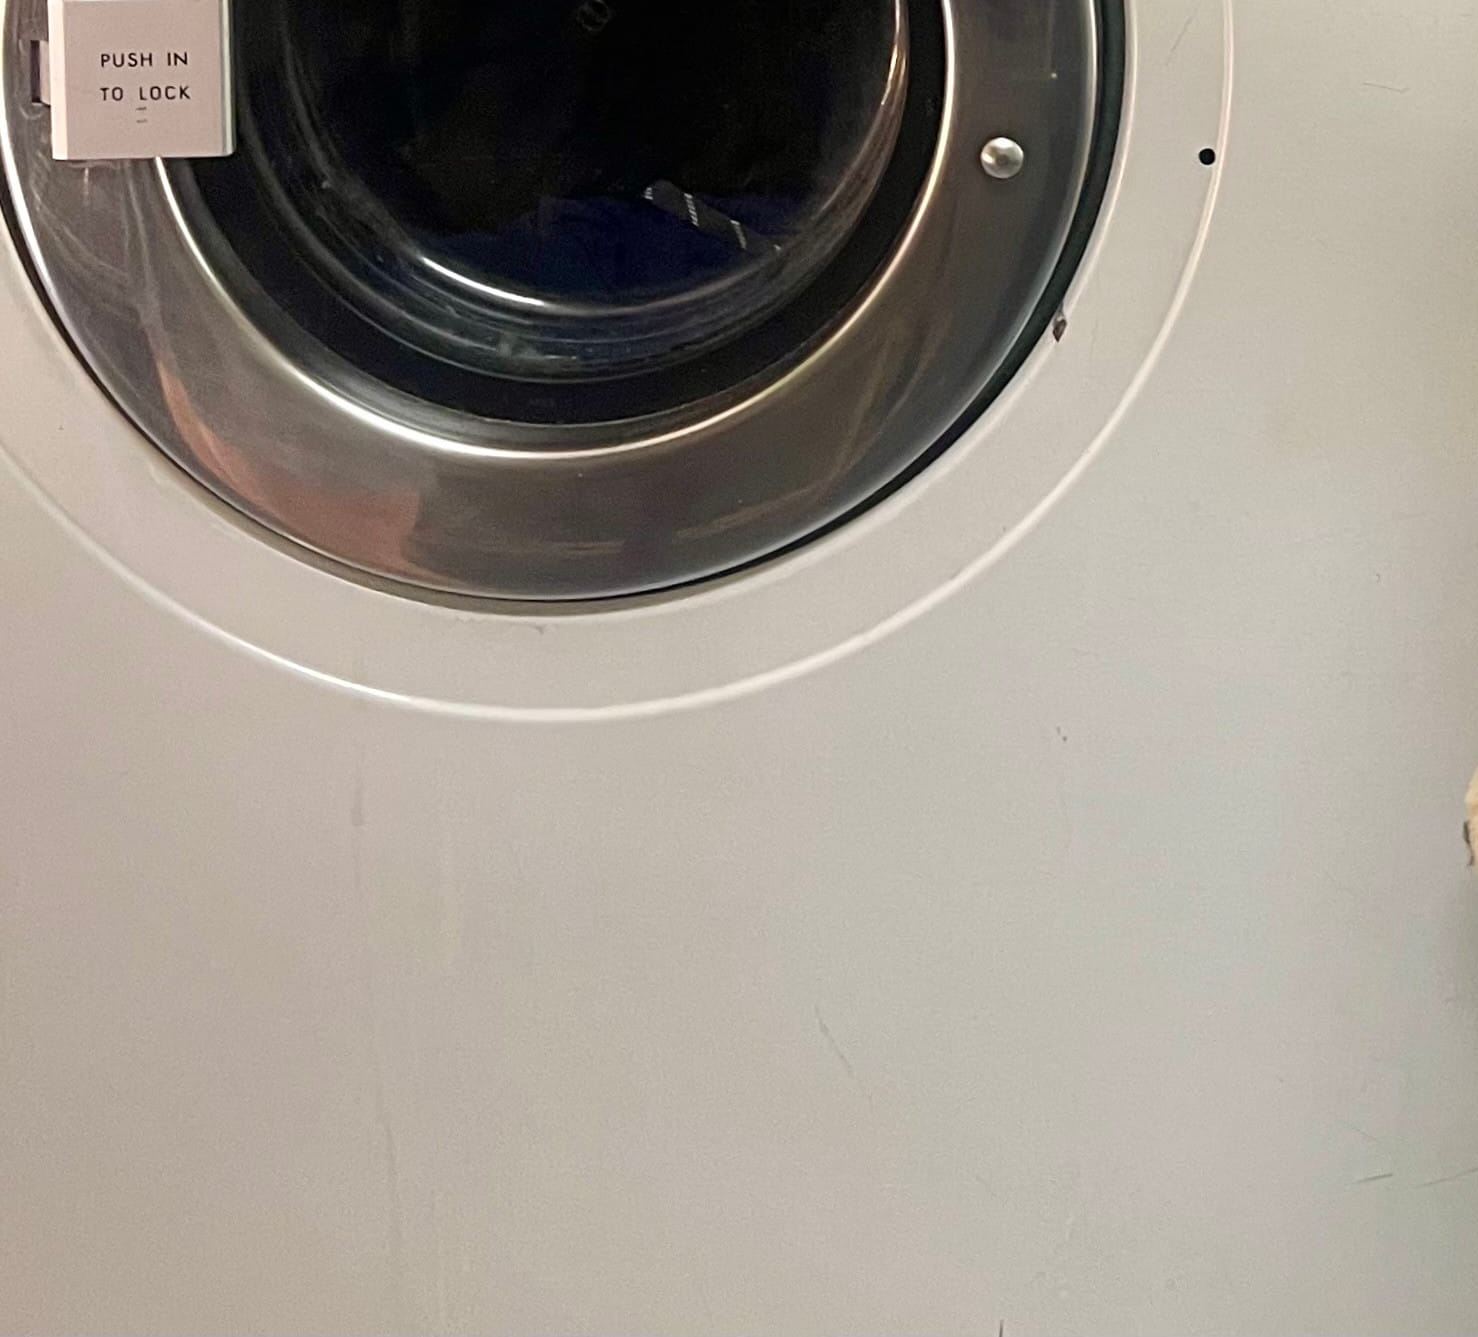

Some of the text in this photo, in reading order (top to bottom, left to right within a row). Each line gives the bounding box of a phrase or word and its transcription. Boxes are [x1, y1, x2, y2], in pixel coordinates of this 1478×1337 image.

[100, 51, 187, 67] PUSH IN
[99, 85, 190, 101] TO LOCK
